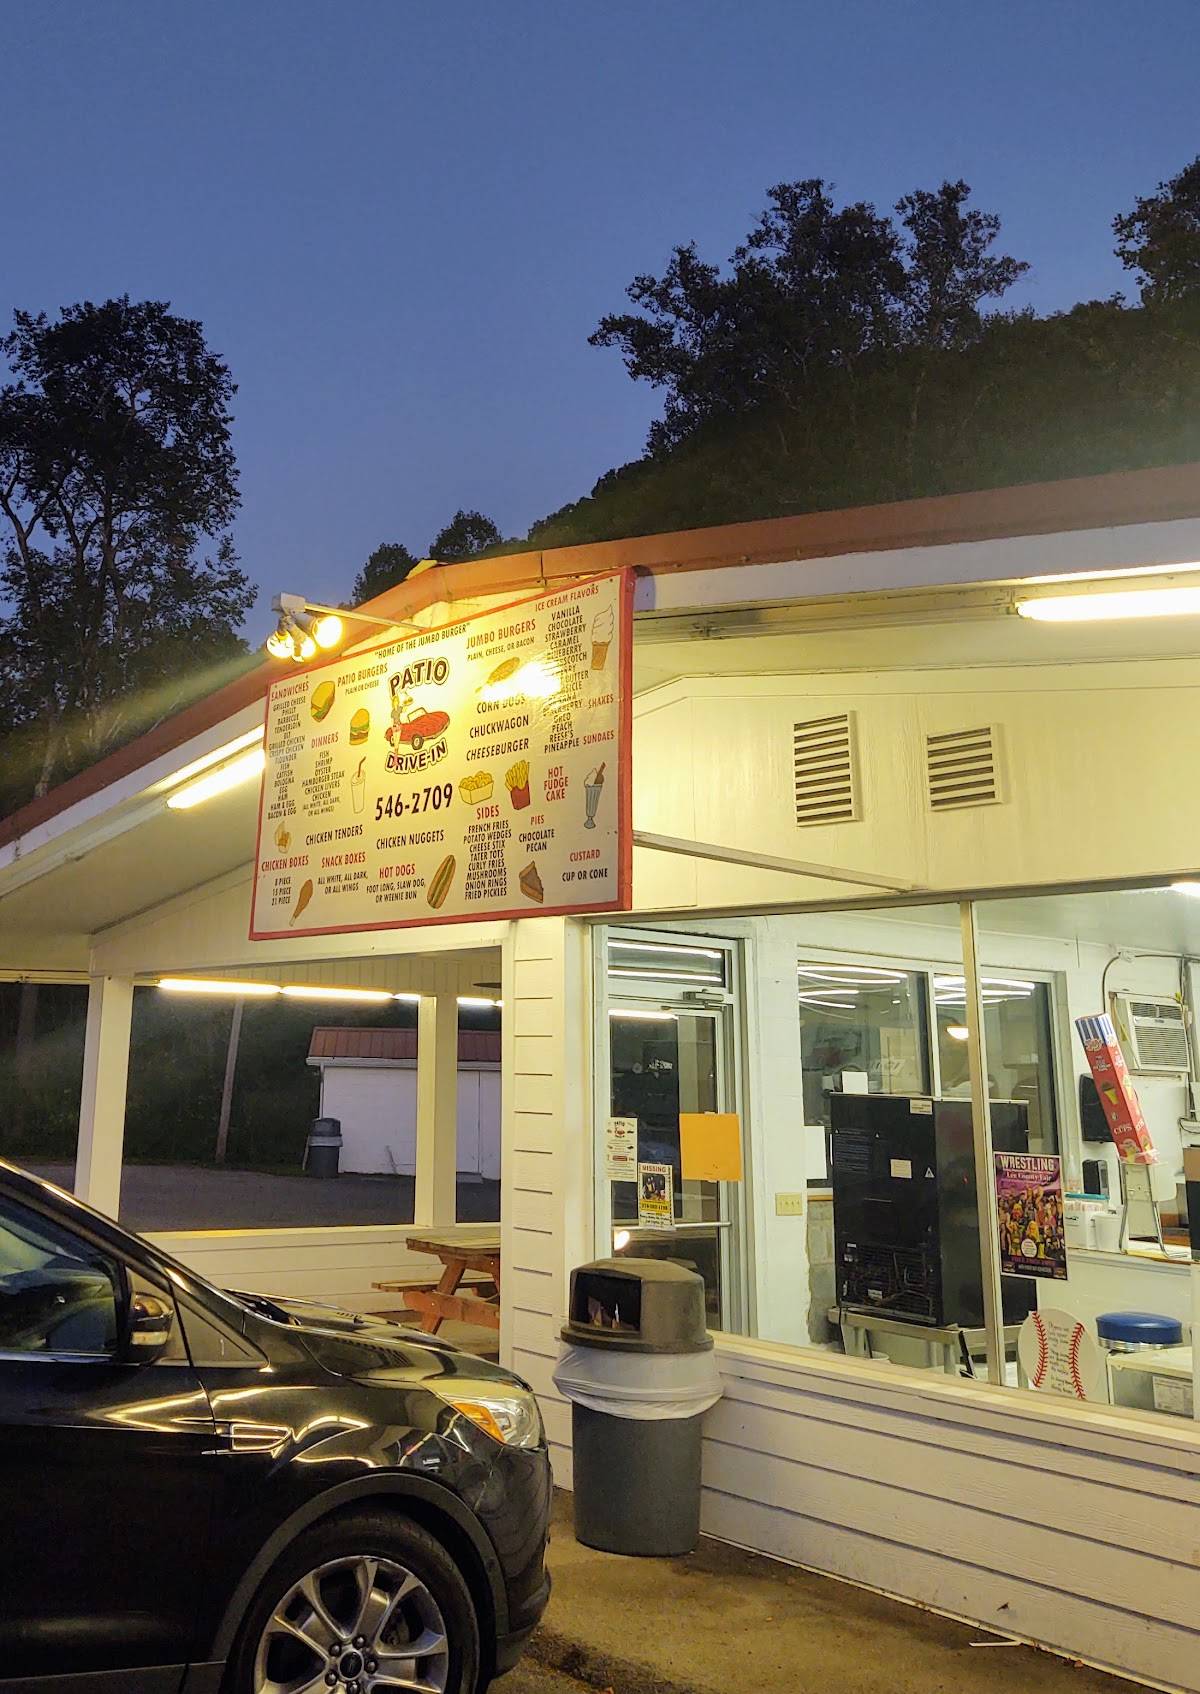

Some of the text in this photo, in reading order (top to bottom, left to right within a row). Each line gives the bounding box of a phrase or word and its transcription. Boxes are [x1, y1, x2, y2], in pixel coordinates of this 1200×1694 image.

[535, 585, 599, 612] ICE CREAM FLAVORS
[552, 605, 580, 620] VANILLA
[548, 615, 583, 632] CHOCOLATE
[466, 618, 536, 649] JUMBO BURGERS
[544, 624, 586, 642] STRAWBERRY
[374, 647, 395, 658] "HOME
[396, 645, 404, 653] OF
[406, 641, 416, 650] THE
[418, 633, 440, 646] JUMBO
[507, 642, 514, 650] OR
[516, 636, 535, 648] BACON
[550, 636, 580, 650] CARAMEL
[338, 662, 388, 687] PATIO BURGERS
[389, 660, 448, 696] PATIO
[272, 681, 309, 701] SANDWICHES
[345, 685, 358, 696] PLAIN
[365, 680, 379, 690] CHEESE
[273, 696, 306, 712] GRILLED CHEESE
[477, 701, 499, 714] CORN
[588, 694, 614, 709] SHAKES
[470, 715, 529, 739] CHUCKWAGON
[552, 721, 573, 733] PEACH
[287, 735, 305, 745] CHICKEN
[312, 732, 338, 748] DINNERS
[550, 730, 574, 742] REESE'S
[583, 730, 615, 745] SUNDAES
[286, 744, 304, 754] CHICKEN
[466, 738, 529, 761] CHEESEBURGER
[544, 738, 580, 754] PINEAPPLE
[320, 751, 329, 760] FISH
[386, 740, 446, 770] DRIVE-IN
[315, 757, 333, 768] SHRIMP
[315, 766, 331, 776] OYSTER
[331, 771, 344, 780] STEAK
[548, 766, 564, 778] HOT
[305, 780, 340, 795] CHICKEN LIVERS
[544, 777, 569, 791] FUDGE
[312, 791, 331, 802] CHICKEN
[375, 783, 453, 821] 546-2709
[546, 788, 566, 802] CAKE
[286, 800, 295, 808] EGG
[268, 810, 282, 820] BACON
[288, 807, 296, 816] EGG
[476, 805, 500, 820] SIDES
[468, 820, 509, 834] FRENCH FRIES
[531, 814, 545, 826] PIES
[306, 824, 363, 846] CHICKEN TENDERS
[376, 829, 445, 850] CHICKEN NUGGETS
[464, 828, 512, 844] POTATO WEDGES
[519, 829, 555, 843] CHOCOLATE
[469, 840, 506, 852] CHEESE STIX
[526, 841, 547, 853] PECAN
[321, 852, 366, 868] SNACK BOXES
[470, 849, 504, 861] TATER TOTS
[570, 849, 601, 862] CUSTARD
[262, 855, 309, 872] CHICKEN BOXES
[468, 858, 505, 872] CURLY FRIES
[344, 873, 352, 881] ALL
[379, 864, 416, 879] HOT DOGS
[466, 868, 507, 881] MUSHROOMS
[562, 868, 608, 882] CUP OR CONE
[278, 877, 291, 886] PIECE
[333, 885, 341, 893] ALL
[342, 883, 359, 892] WINGS
[366, 884, 378, 894] FOOT
[397, 880, 412, 890] SLAW
[465, 877, 507, 891] ONION RINGS
[279, 887, 291, 896] PIECE
[376, 890, 417, 903] OR WEENIE BUN
[465, 886, 507, 900] FRIED PICKLES
[278, 896, 290, 904] PIECE
[642, 1165, 667, 1173] MISSING
[1000, 1155, 1055, 1172] WRESTLING
